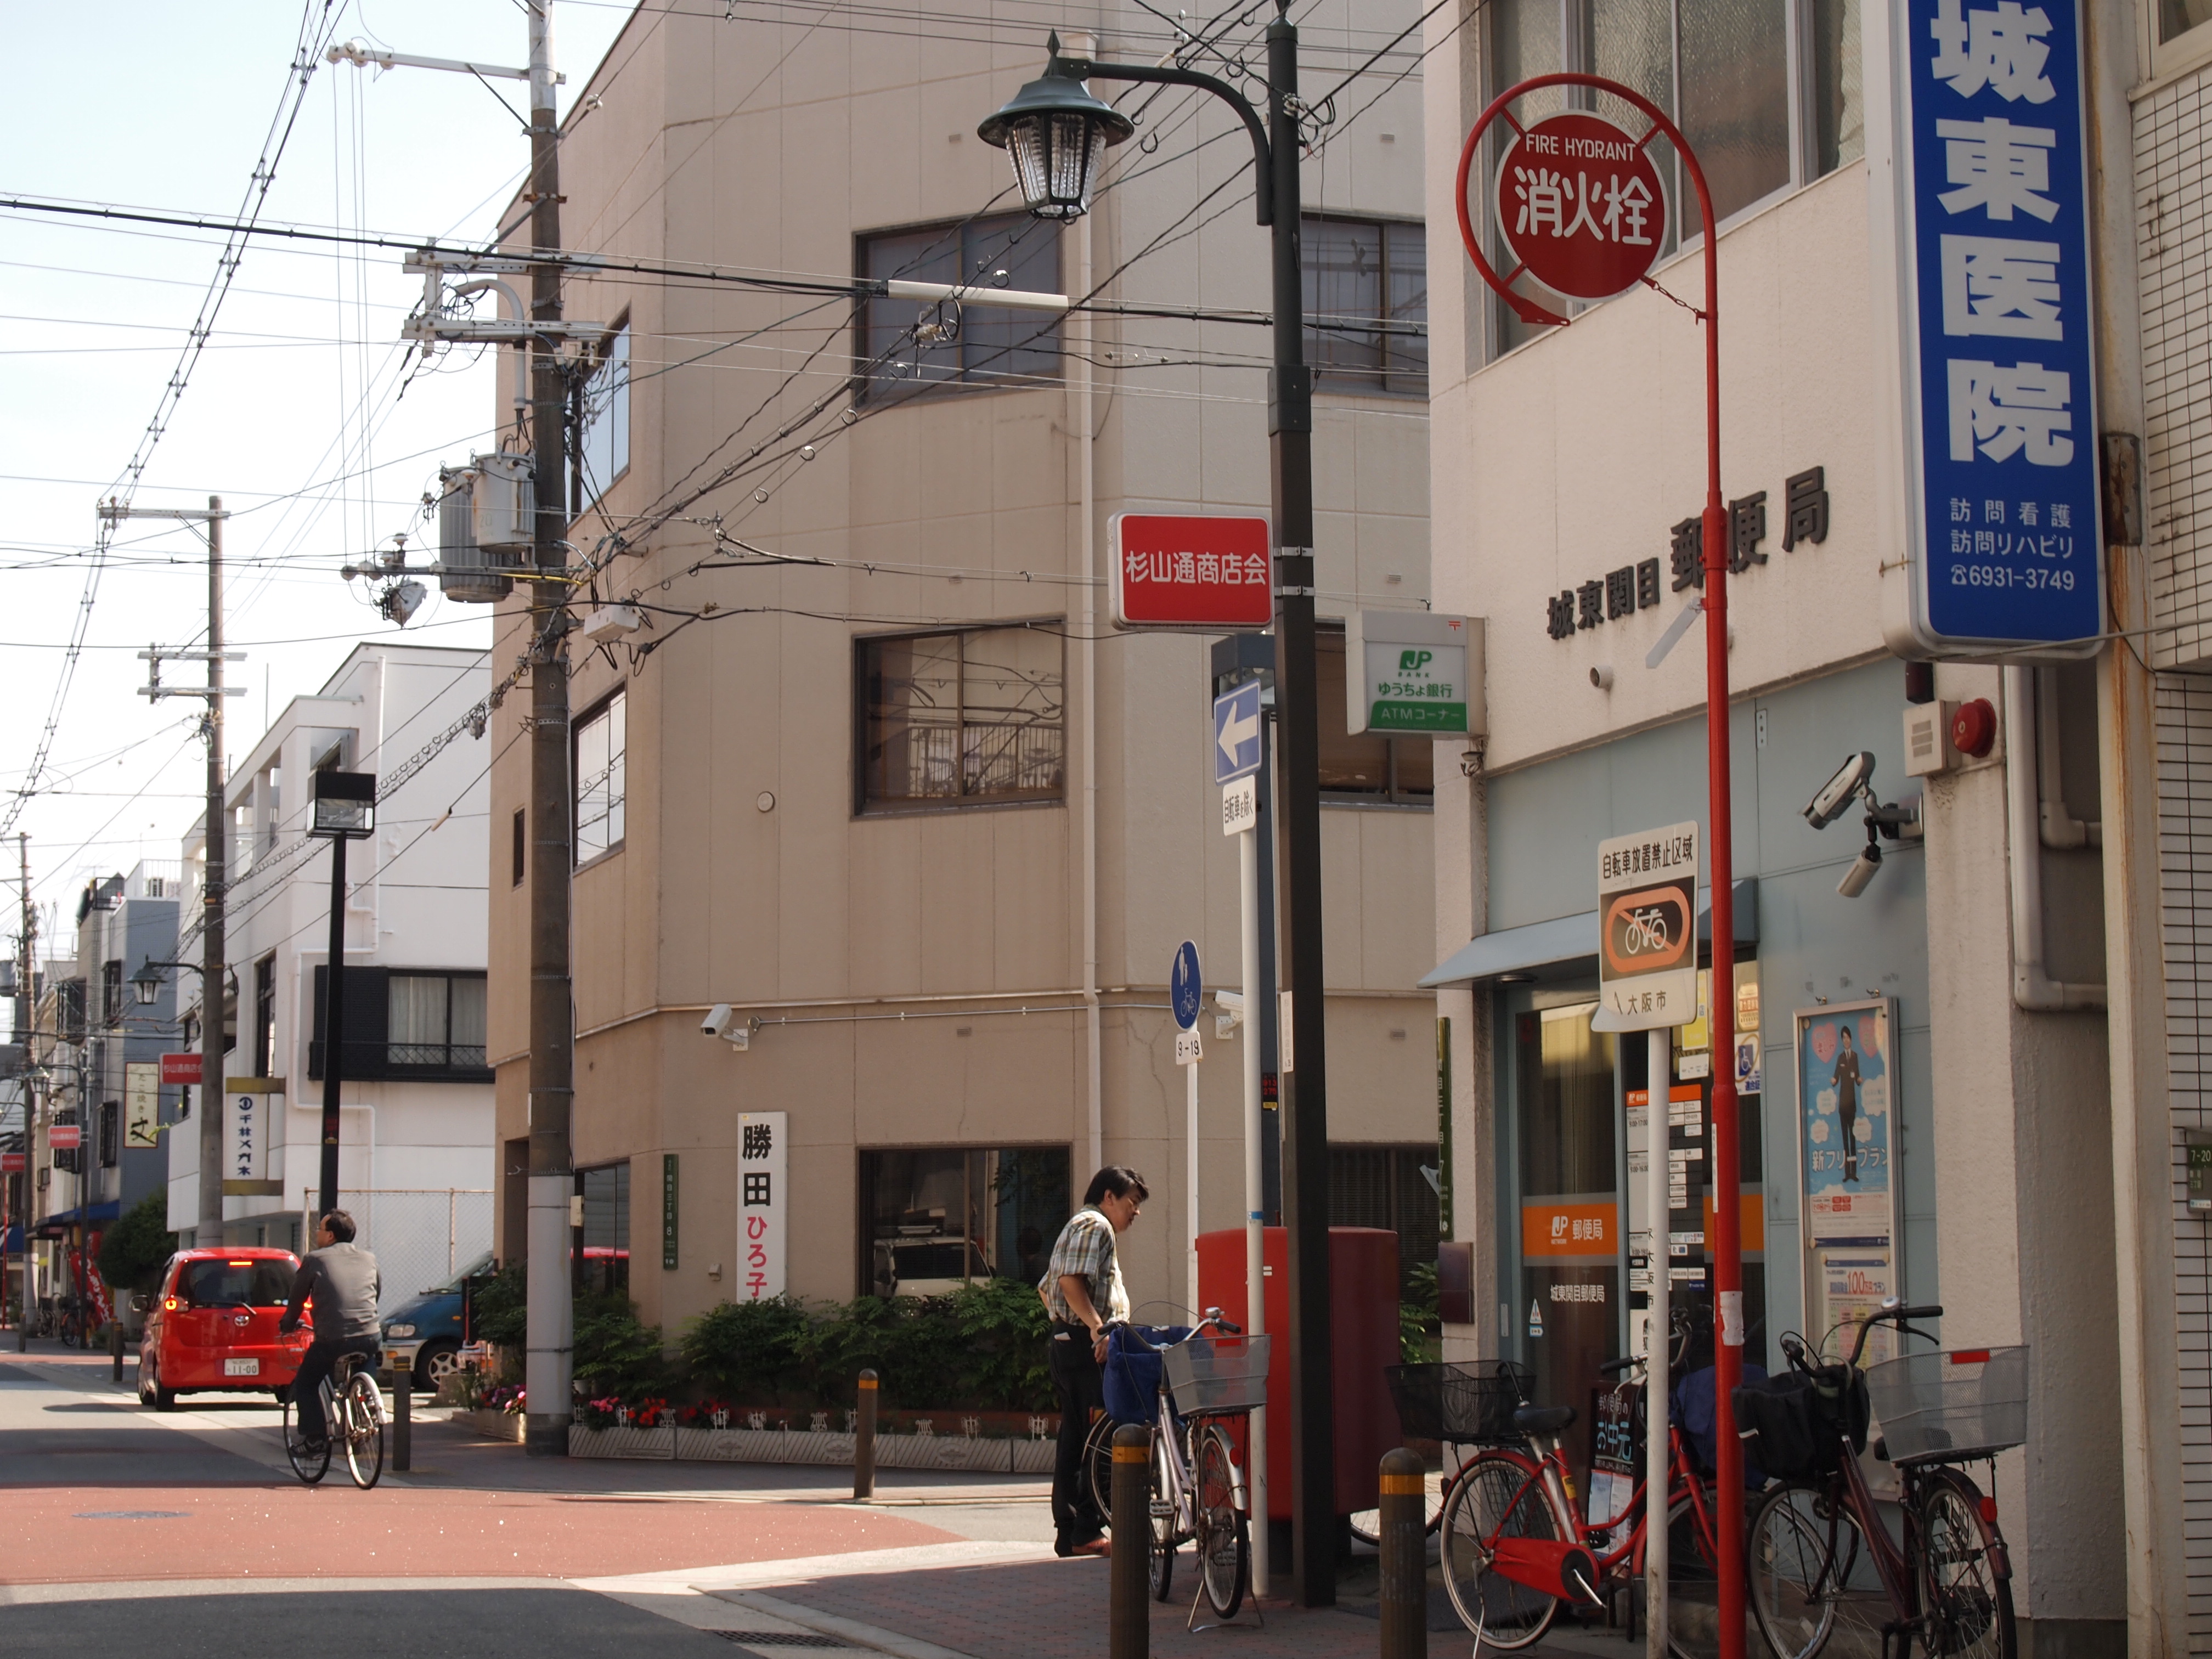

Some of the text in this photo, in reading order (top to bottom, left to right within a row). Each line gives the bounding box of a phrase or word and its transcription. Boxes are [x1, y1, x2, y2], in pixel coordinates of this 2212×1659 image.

[1526, 133, 1637, 162] FIRE HYDRANT
[1514, 166, 1653, 246] 消火栓
[1931, 0, 2074, 466] 城東医院
[1950, 497, 2072, 529] 訪問看護
[1547, 465, 1829, 640] 城東関目 郵便局
[1950, 529, 2073, 559] 訪問リハビリ
[1125, 550, 1267, 586] 杉山通商店会
[1969, 565, 2075, 591] 6931-3749
[1400, 650, 1432, 670] JP
[1379, 681, 1453, 698] ゆうちょ銀行
[1381, 707, 1460, 721] ATMコーナー
[1224, 789, 1254, 824] 自転車を除く
[1603, 833, 1693, 879] 自転車放置禁止区域
[1627, 989, 1667, 1015] 大阪市
[1177, 1039, 1200, 1057] 9-19
[742, 1124, 772, 1297] 勝田ひろ子
[1572, 1218, 1603, 1240] 郵便局
[1550, 1284, 1605, 1303] 城東関目郵便局
